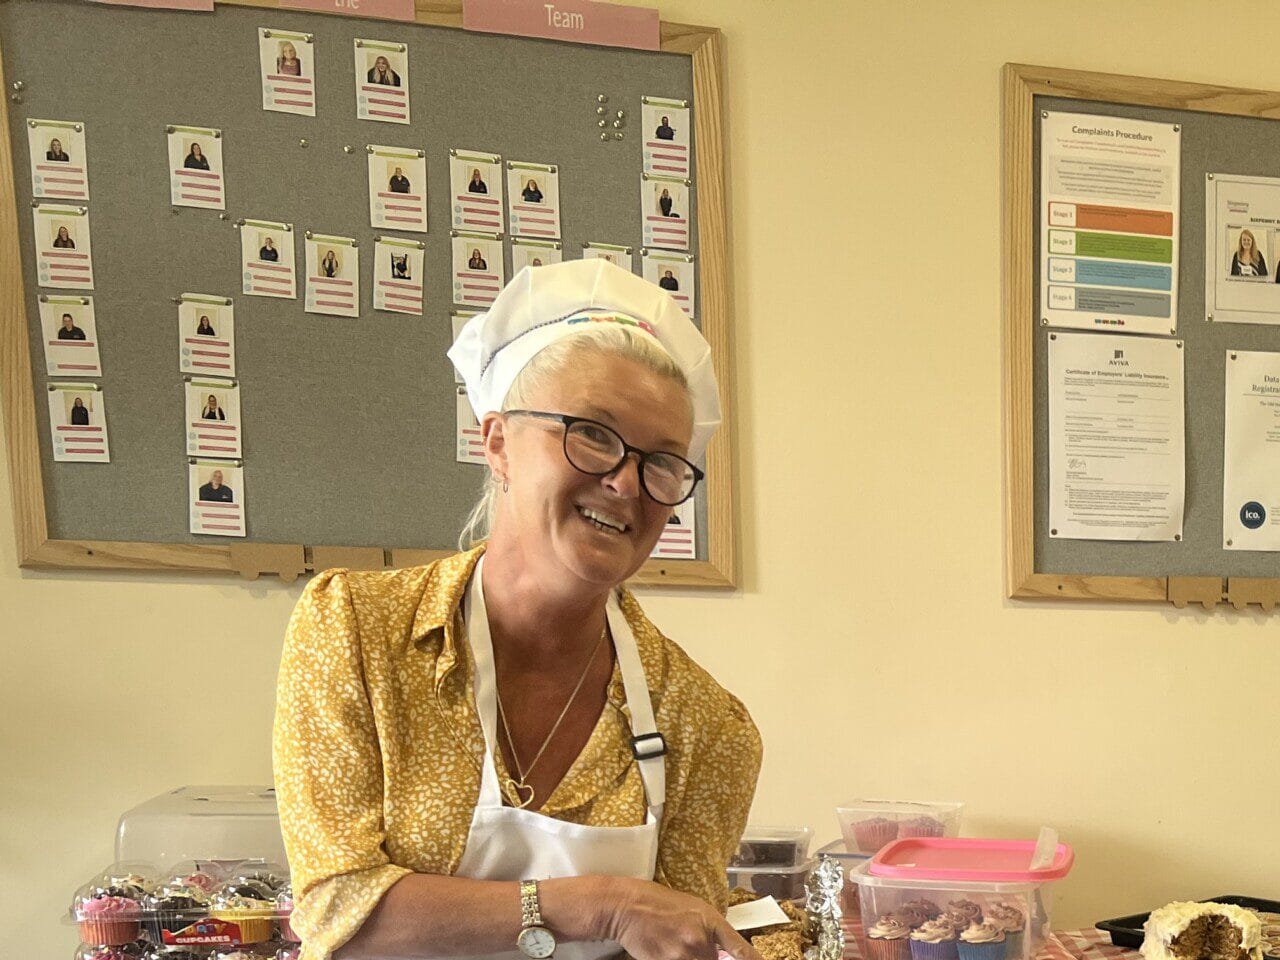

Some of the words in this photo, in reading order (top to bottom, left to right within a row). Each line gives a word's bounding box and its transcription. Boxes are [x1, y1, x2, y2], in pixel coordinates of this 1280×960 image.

[544, 4, 584, 31] Team
[1072, 126, 1114, 137] Complaints
[1115, 130, 1153, 142] Procedure
[1264, 375, 1279, 383] Data
[175, 935, 231, 944] CUPCAKES
